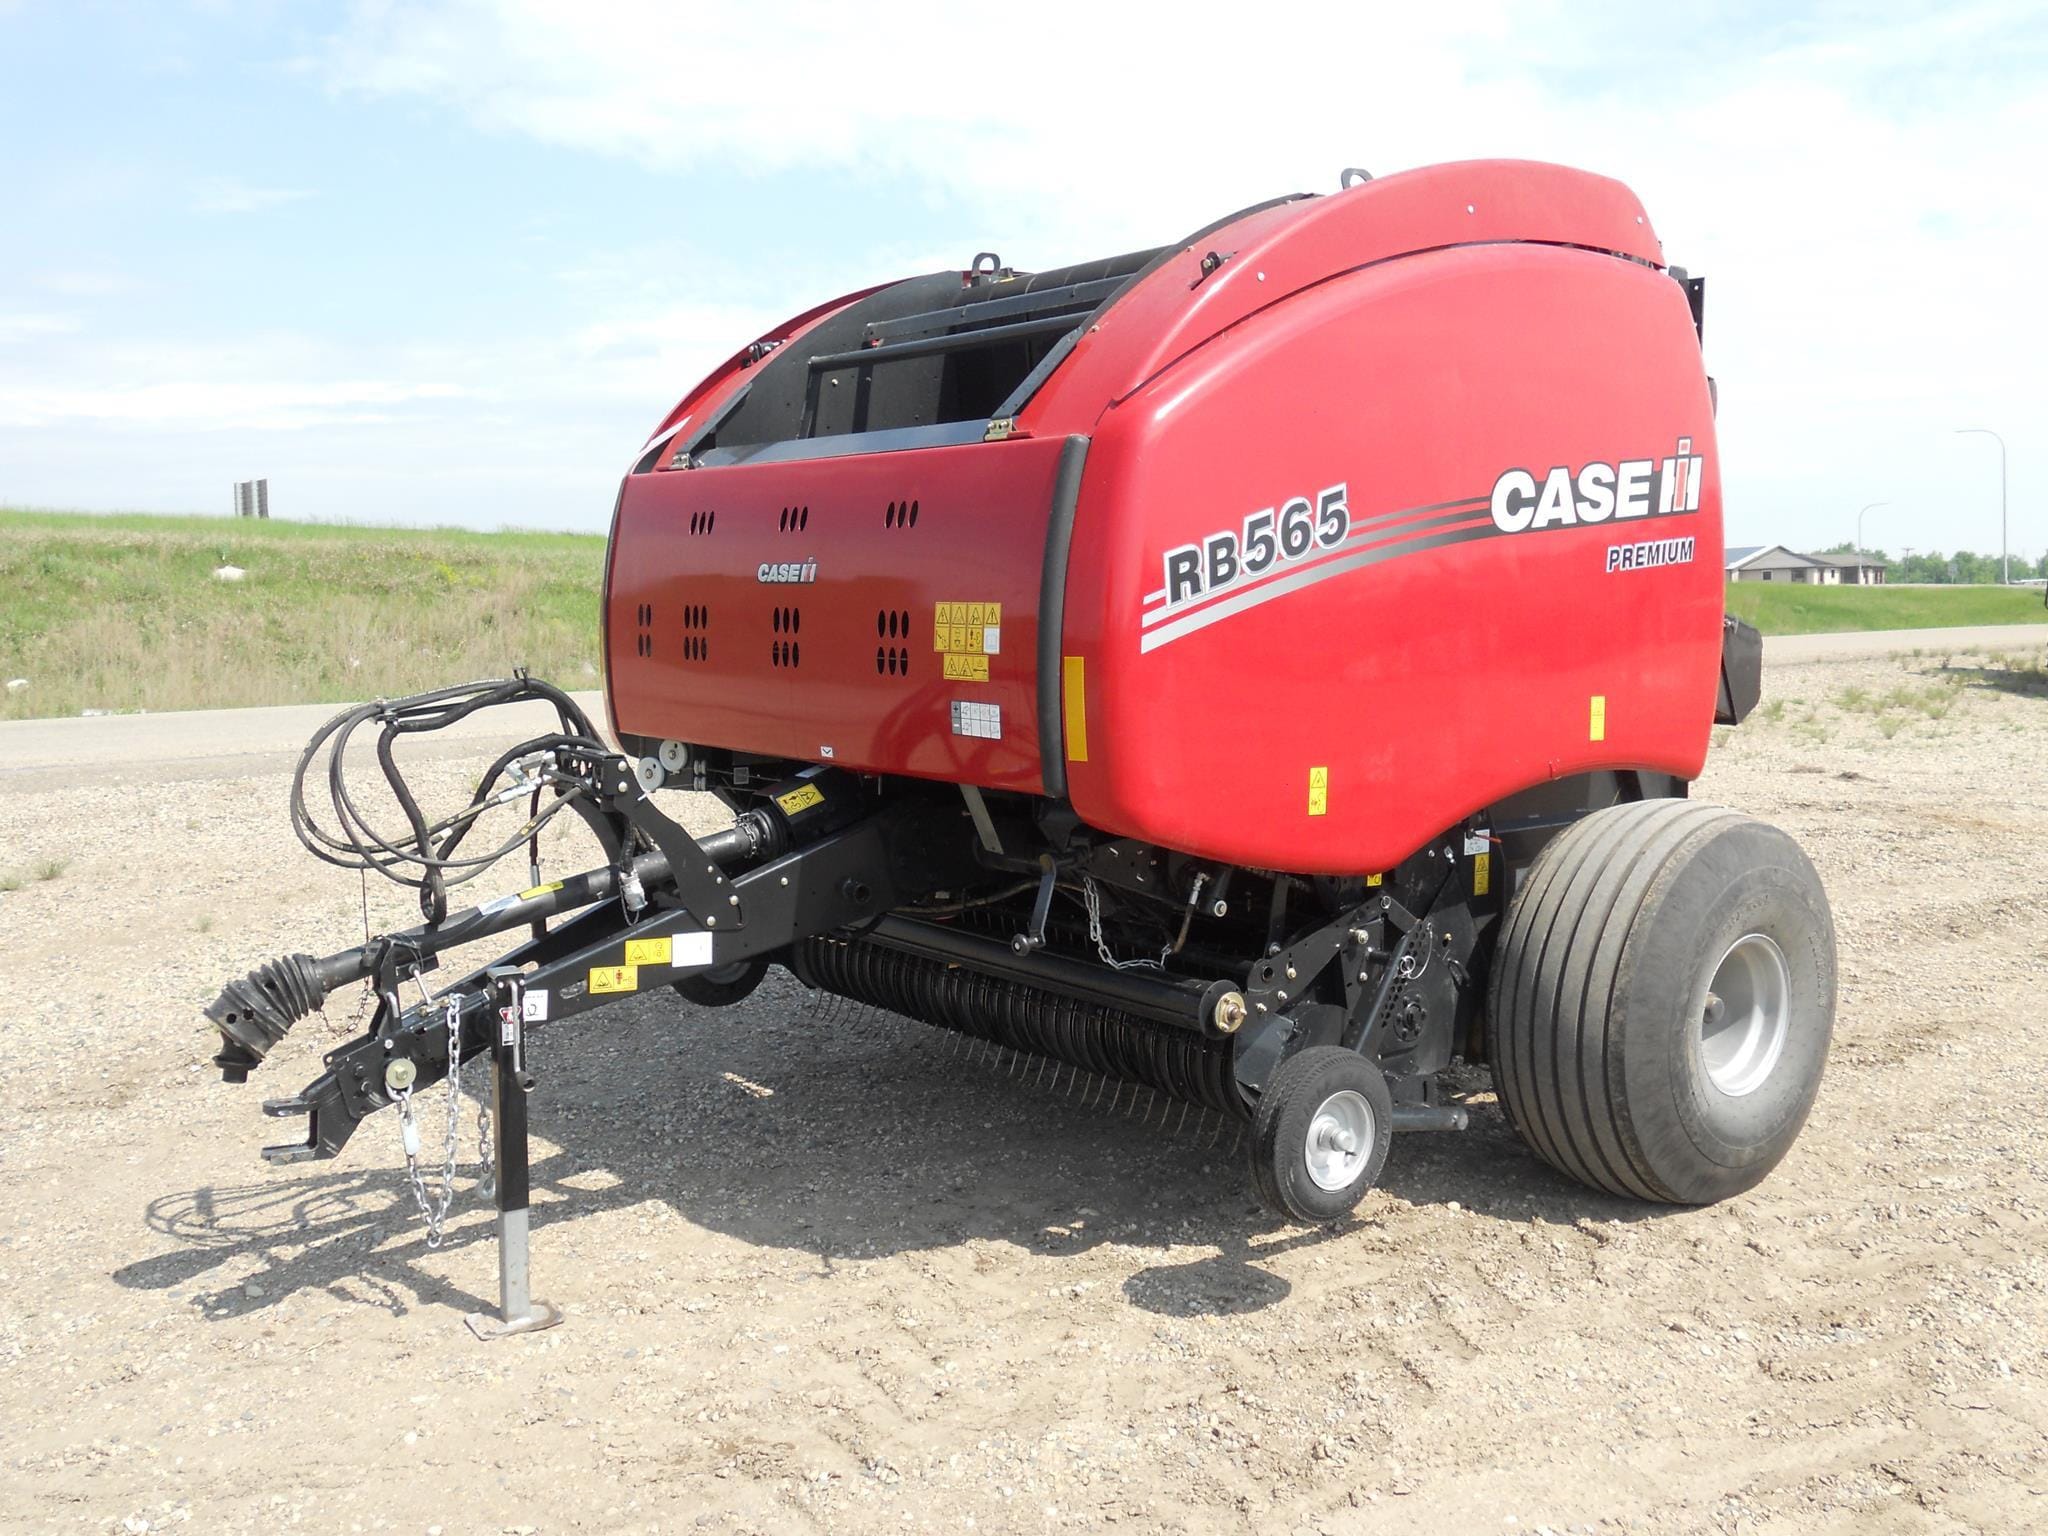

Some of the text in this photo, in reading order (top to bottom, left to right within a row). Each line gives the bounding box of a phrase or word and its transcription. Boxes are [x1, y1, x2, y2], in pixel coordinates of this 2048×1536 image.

[1490, 459, 1654, 533] CASE
[757, 563, 800, 583] CASE
[1163, 482, 1350, 609] RB565
[1606, 536, 1695, 573] PREMIUM
